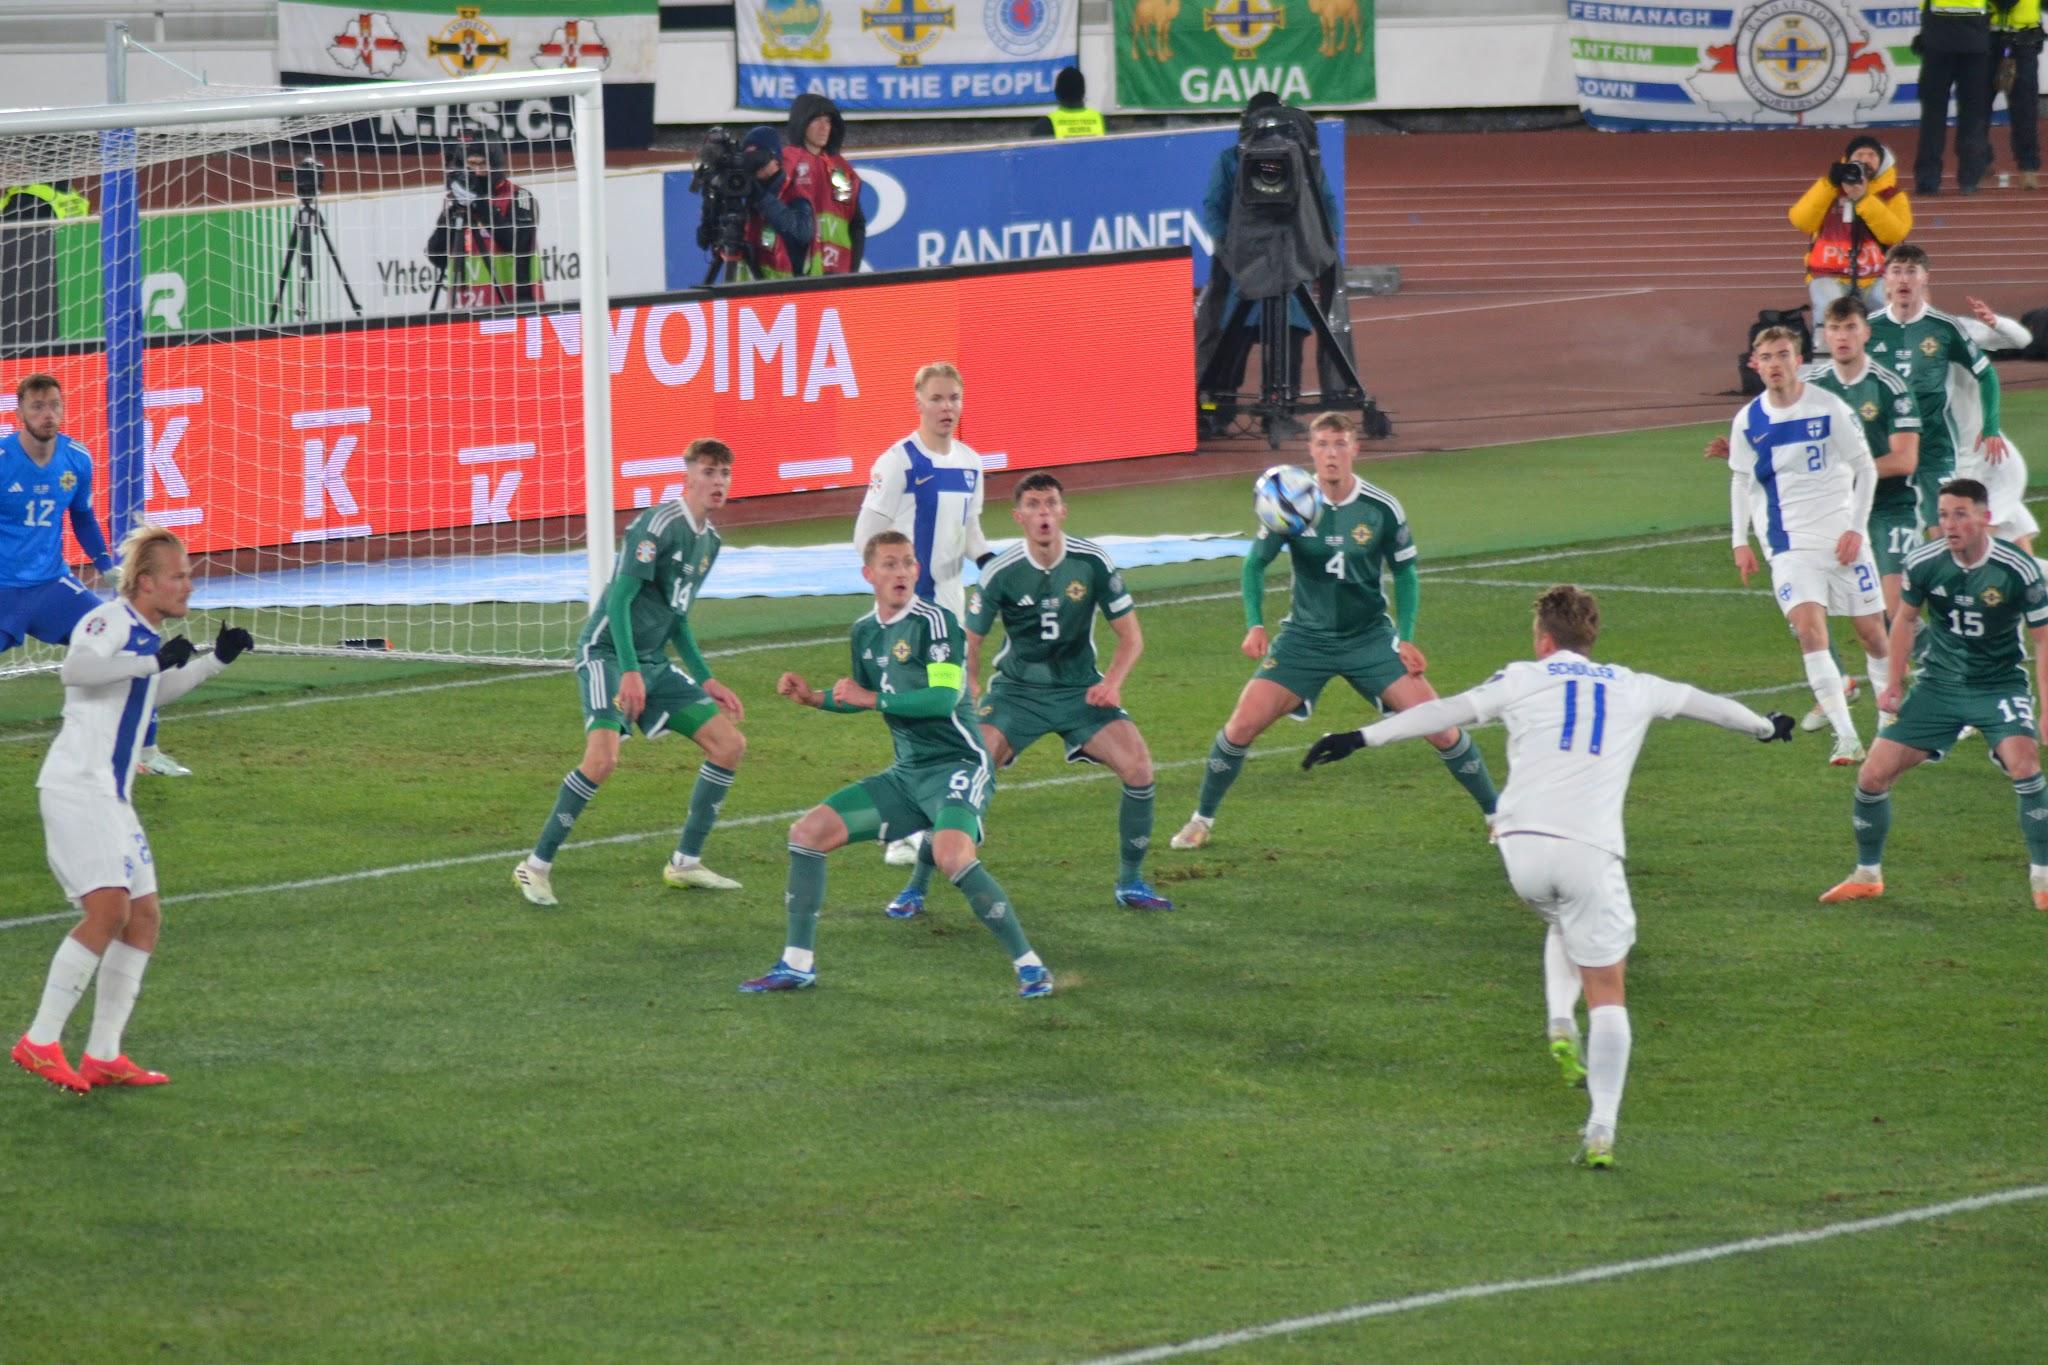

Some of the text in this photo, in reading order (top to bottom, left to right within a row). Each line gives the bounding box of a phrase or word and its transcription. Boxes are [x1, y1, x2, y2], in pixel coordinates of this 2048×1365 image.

[1570, 3, 1710, 26] FERMANAGH
[1571, 42, 1653, 62] ANTRIM
[751, 75, 795, 99] WE
[807, 75, 868, 100] ARE
[877, 75, 941, 99] THE
[1180, 66, 1311, 103] GAWA
[304, 435, 359, 518] K
[24, 500, 56, 527] 12
[1888, 527, 1914, 553] 17
[1325, 551, 1345, 580] 4
[671, 578, 692, 612] 14
[1041, 612, 1060, 640] 5
[1948, 609, 1985, 637] 15
[1559, 680, 1606, 757] 11
[1998, 696, 2034, 723] 15
[949, 770, 969, 791] 6
